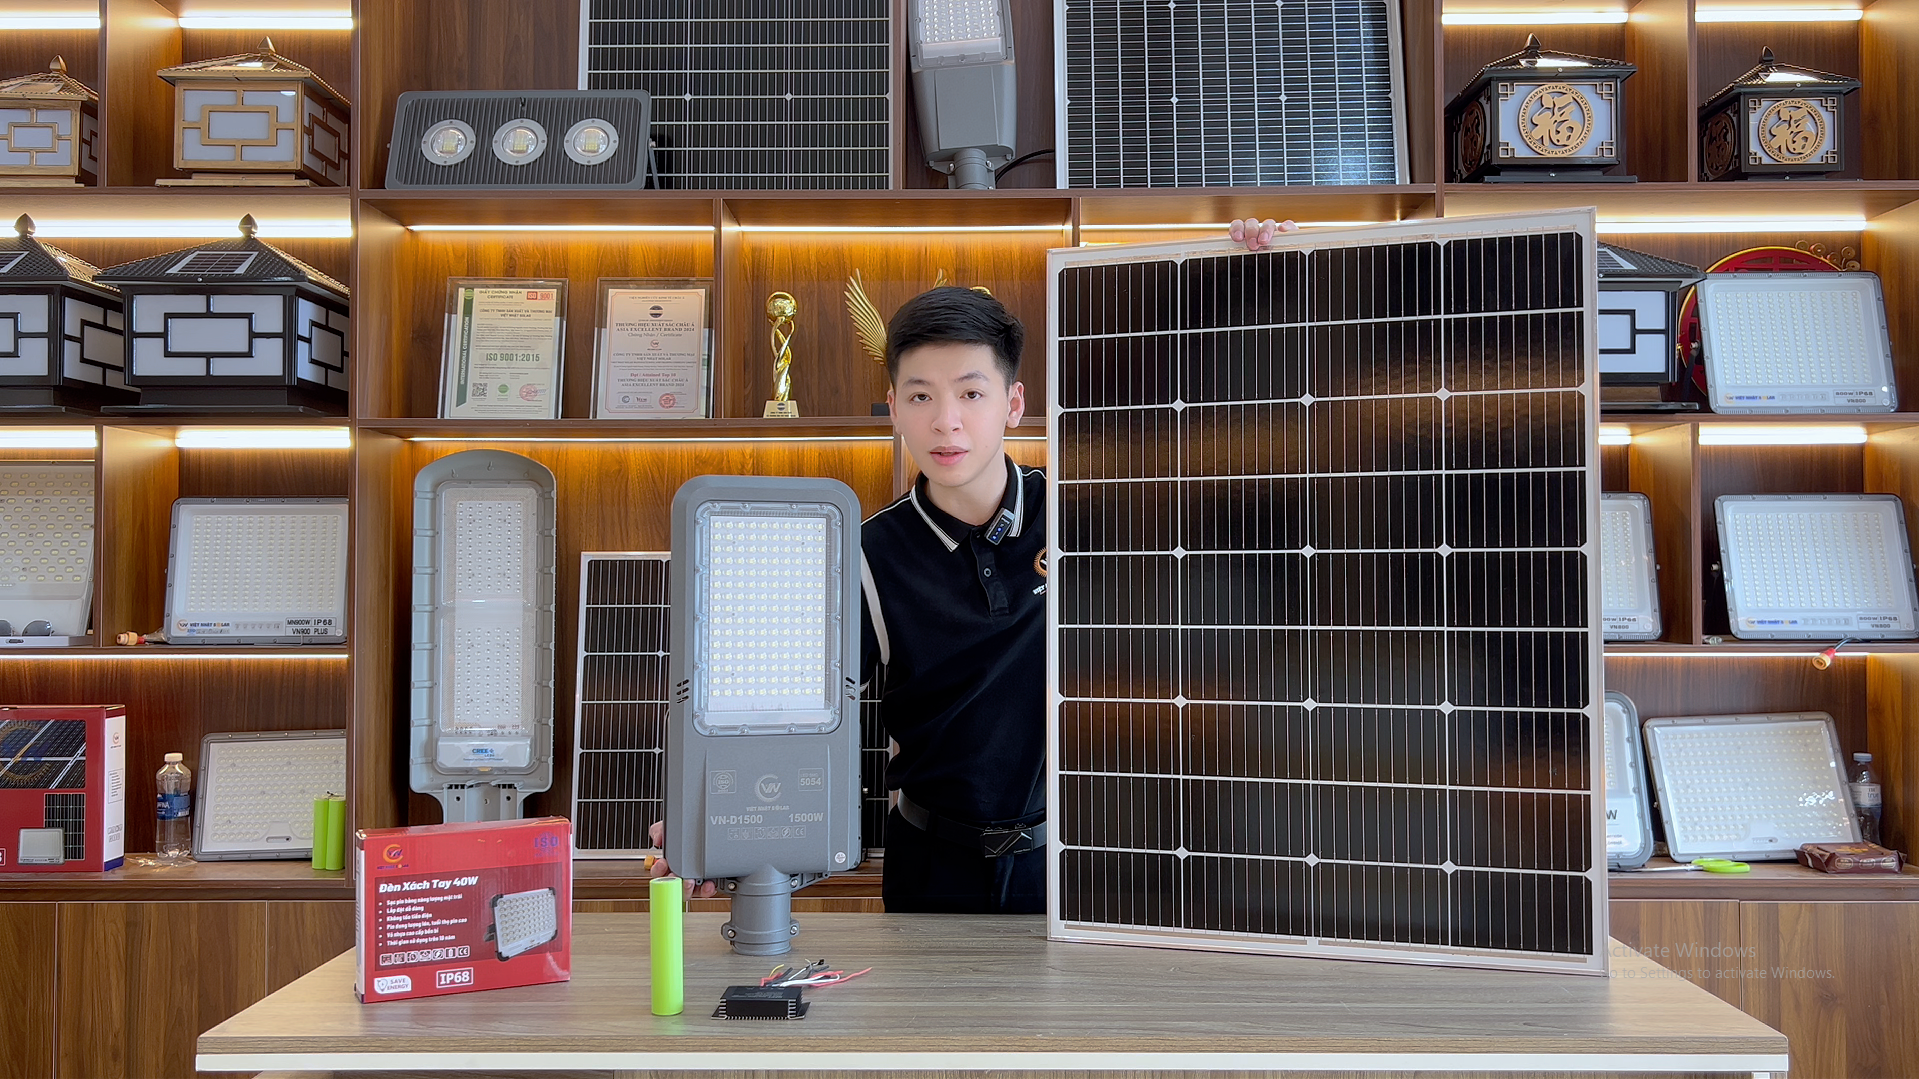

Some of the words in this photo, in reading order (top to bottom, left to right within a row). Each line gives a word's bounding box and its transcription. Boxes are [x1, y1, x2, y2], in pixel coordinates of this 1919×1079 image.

[486, 353, 498, 361] ISO
[500, 353, 540, 362] 9001:2015
[800, 777, 821, 786] 5054
[710, 815, 763, 825] VN-D1500
[788, 813, 824, 823] 1500W
[534, 836, 558, 848] ISO
[379, 883, 401, 893] Đèn
[402, 881, 430, 891] Xách
[431, 879, 452, 889] Tay
[453, 876, 478, 887] 40W
[439, 971, 470, 985] IP68
[387, 983, 409, 991] ENERGY
